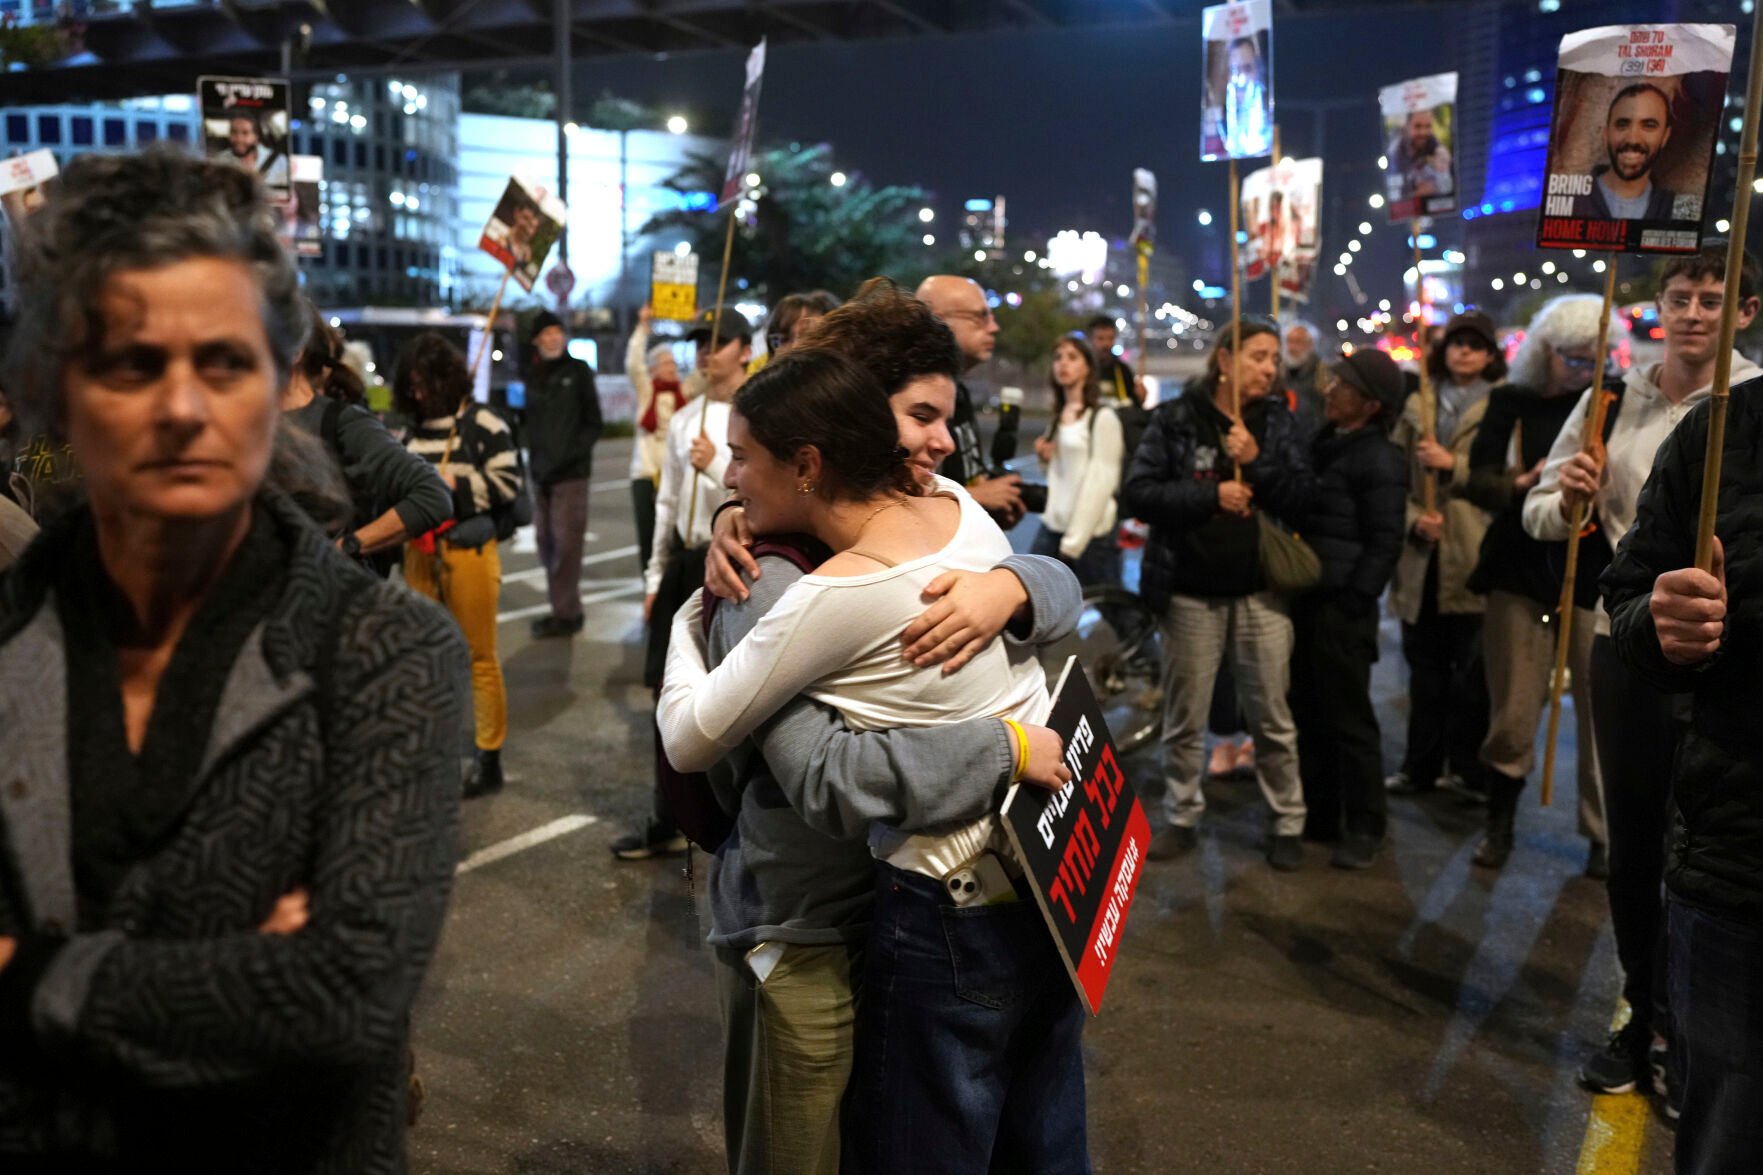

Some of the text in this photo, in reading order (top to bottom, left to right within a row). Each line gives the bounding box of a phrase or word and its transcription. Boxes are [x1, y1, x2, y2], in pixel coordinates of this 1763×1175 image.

[1548, 174, 1593, 196] BRING
[1545, 195, 1575, 217] HIM
[1543, 219, 1629, 243] HOME NOW!
[1066, 714, 1095, 781] פדיון
[1049, 744, 1125, 923] בכל מחיר
